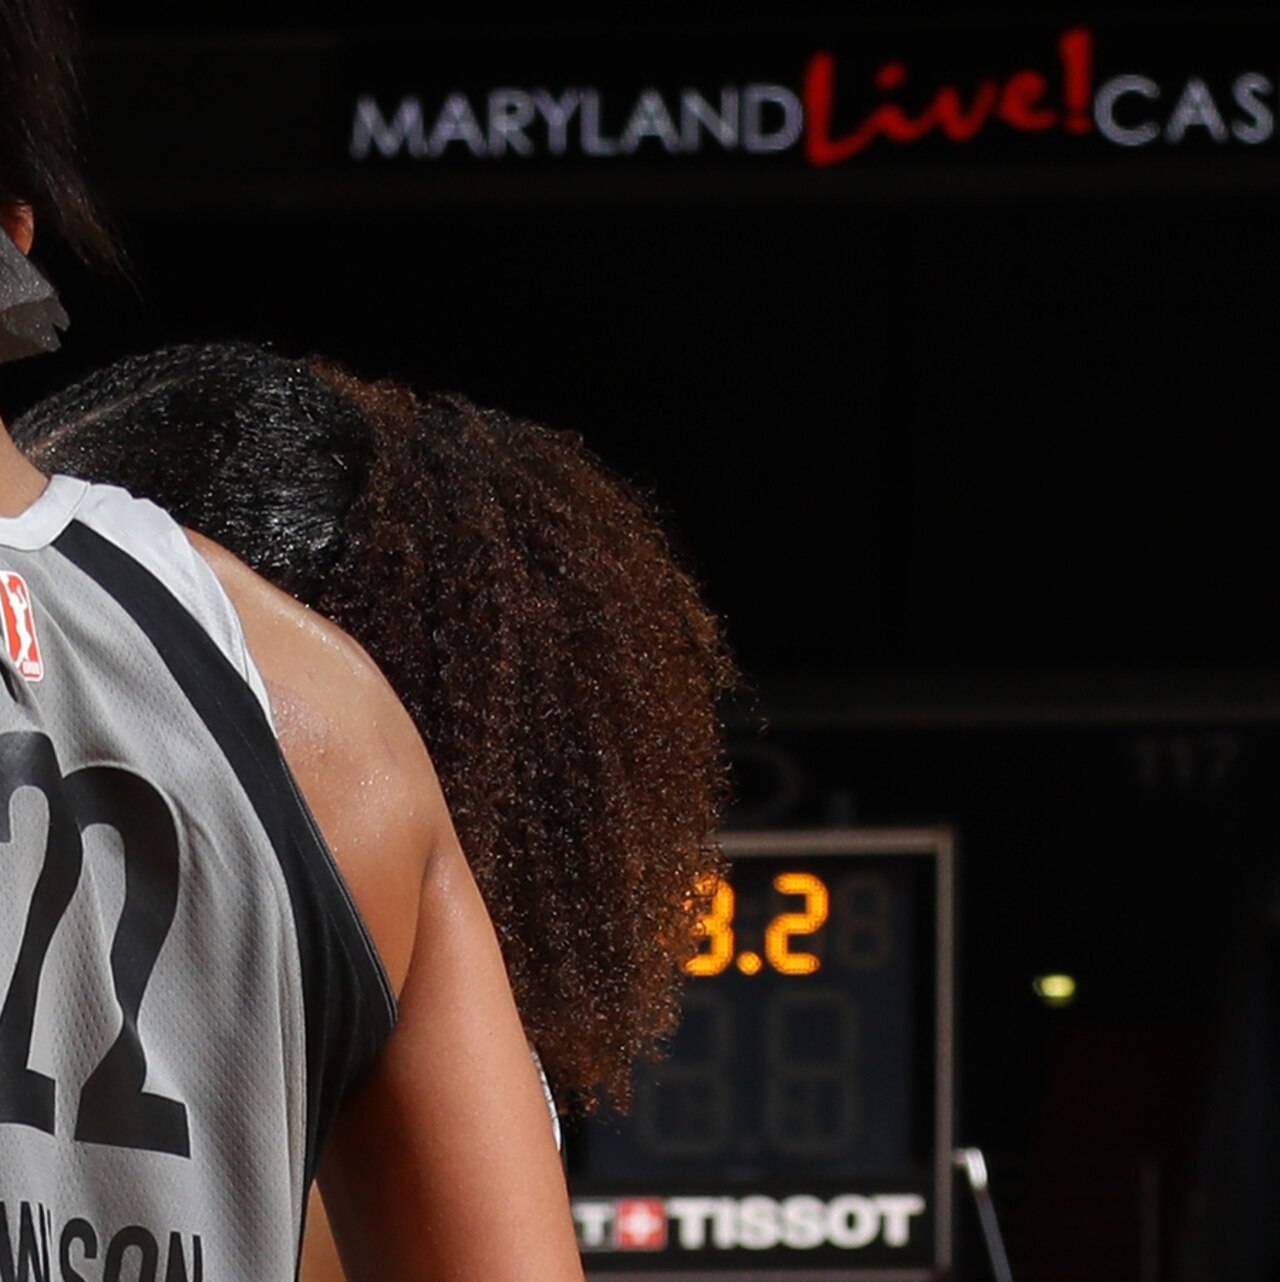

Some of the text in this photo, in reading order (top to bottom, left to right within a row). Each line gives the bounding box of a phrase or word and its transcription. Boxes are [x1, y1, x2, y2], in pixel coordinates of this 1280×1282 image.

[349, 26, 1275, 166] MARYLAND Live! CAS
[666, 1192, 926, 1250] TISSOT
